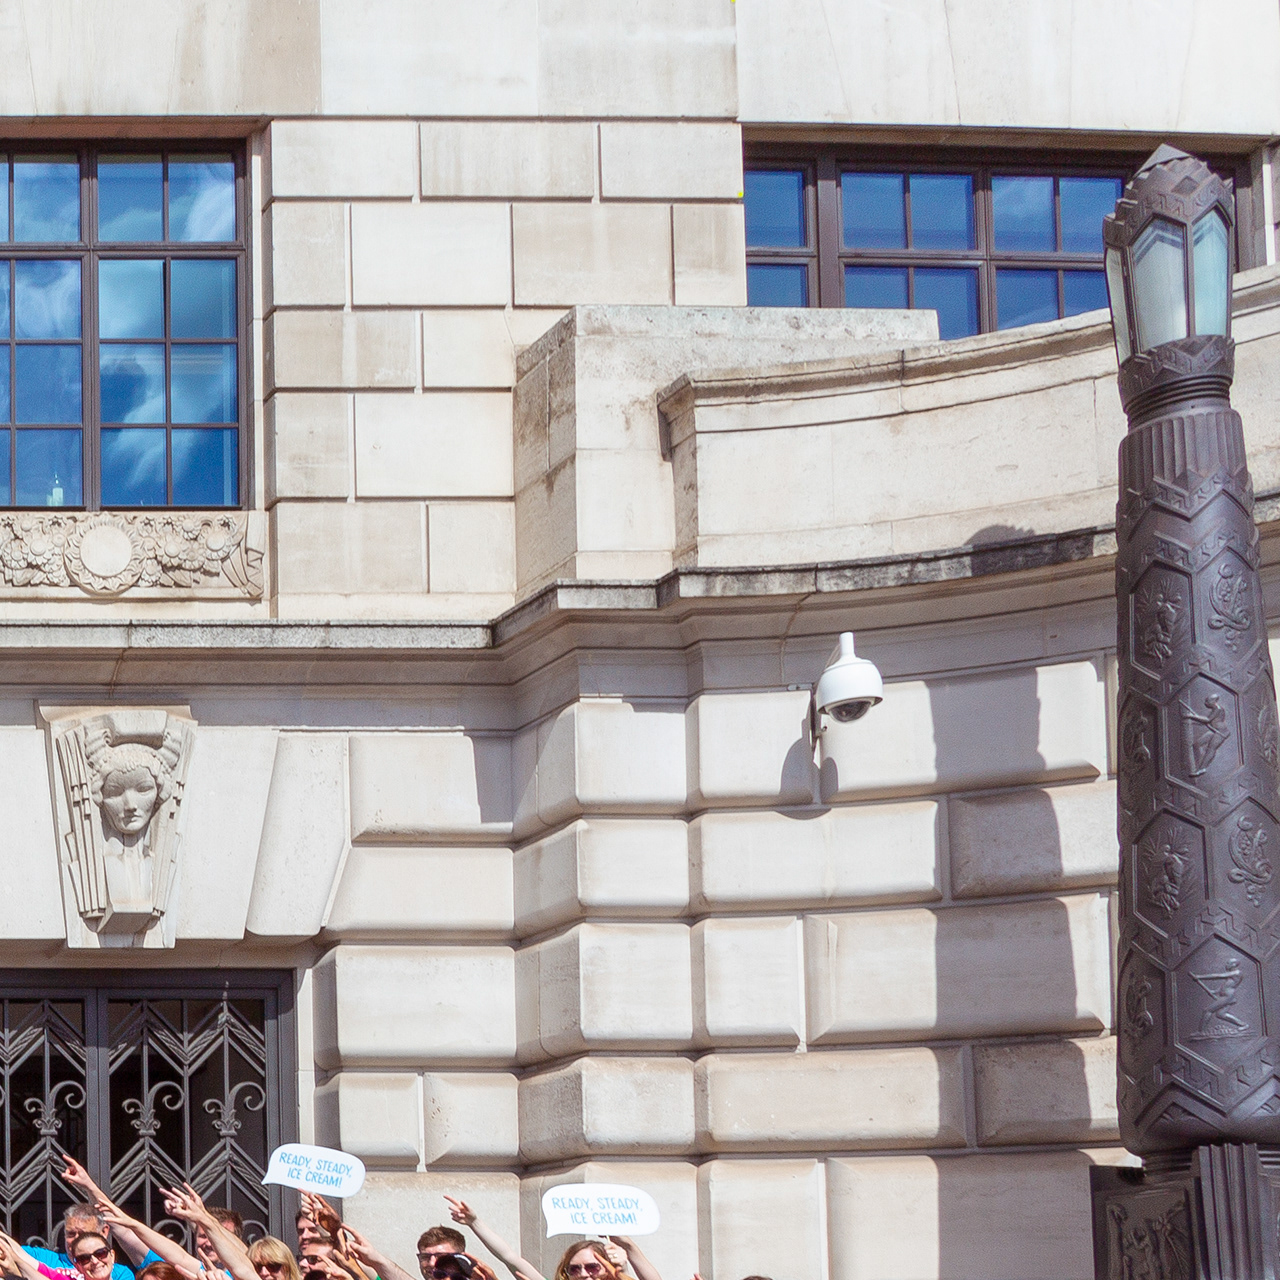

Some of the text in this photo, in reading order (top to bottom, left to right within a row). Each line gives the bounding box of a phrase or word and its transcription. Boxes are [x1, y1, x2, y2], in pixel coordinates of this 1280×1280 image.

[279, 1152, 353, 1178] READY, STEADY,
[287, 1167, 343, 1188] ICE CREAM!
[552, 1197, 593, 1211] READY,
[570, 1212, 638, 1225] ICE CREAM!
